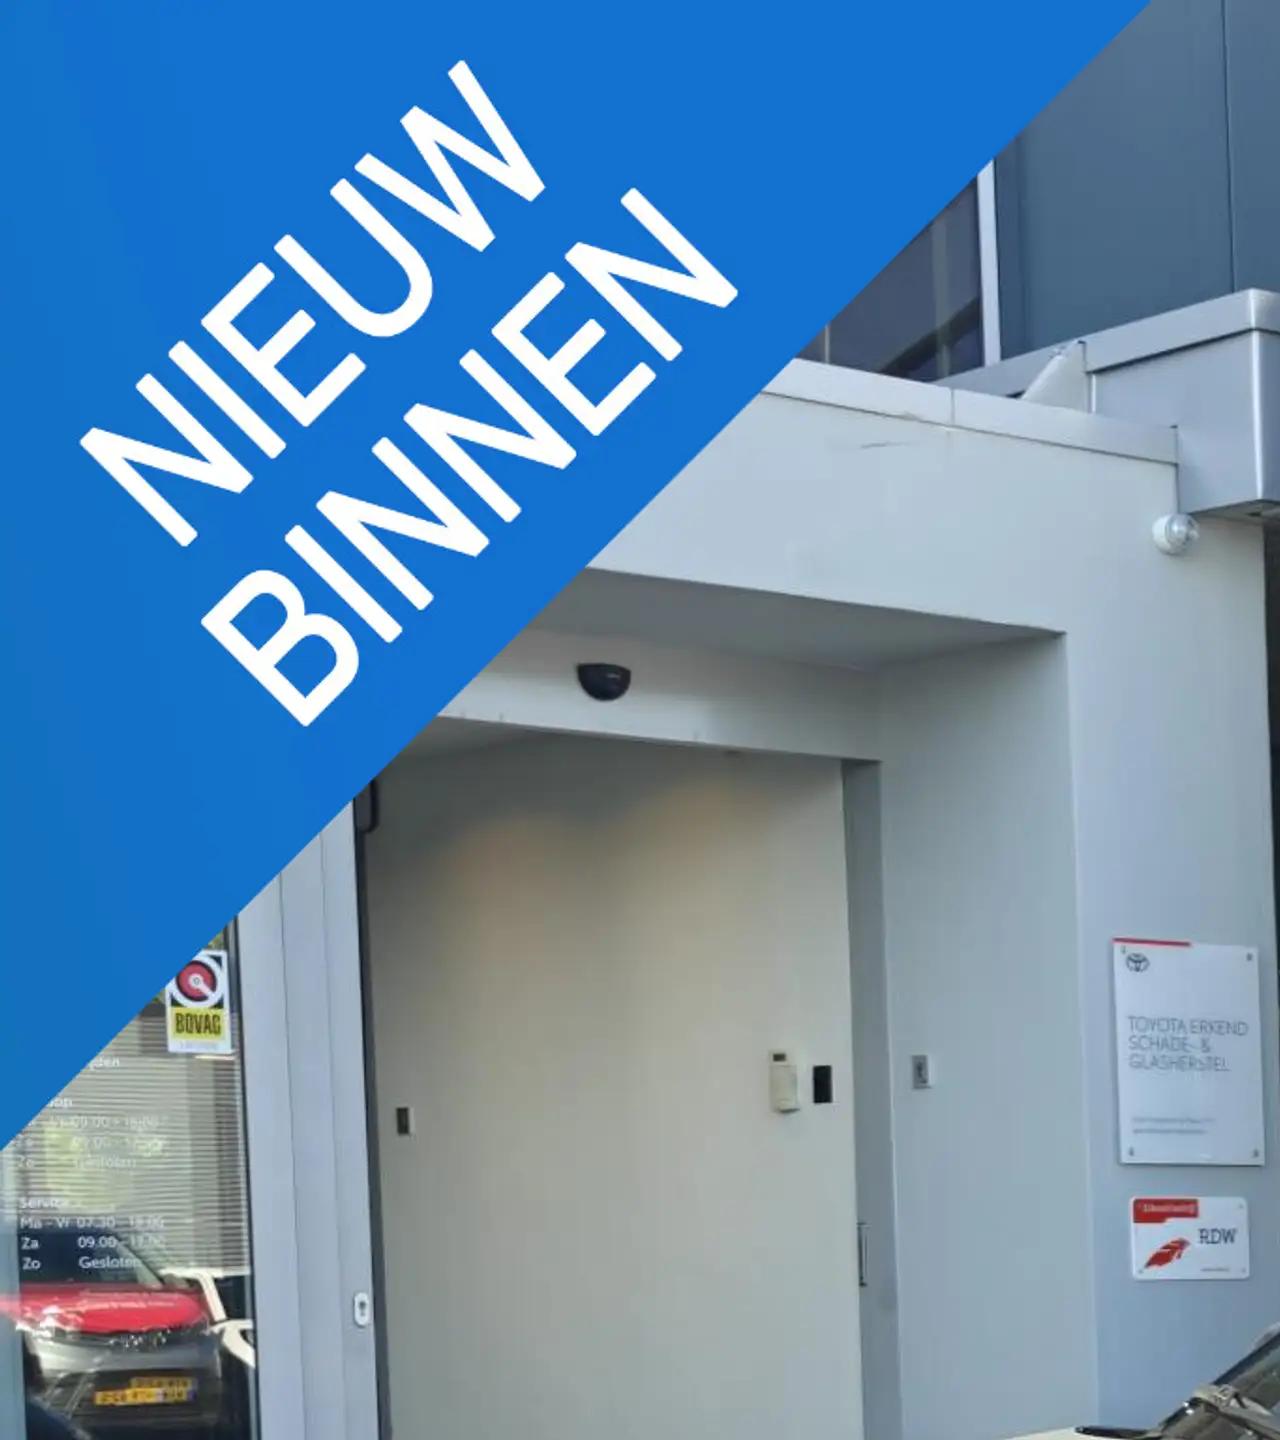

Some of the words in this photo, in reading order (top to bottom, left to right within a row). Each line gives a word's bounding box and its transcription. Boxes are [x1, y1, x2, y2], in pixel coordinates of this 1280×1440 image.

[175, 1012, 222, 1035] BOVAG
[1127, 1015, 1188, 1034] TOYOTA
[1190, 1019, 1250, 1036] ERKEND
[21, 1237, 40, 1249] Za
[1199, 1227, 1238, 1244] RDW
[22, 1257, 41, 1270] Zo
[78, 1255, 143, 1269] Gesloten
